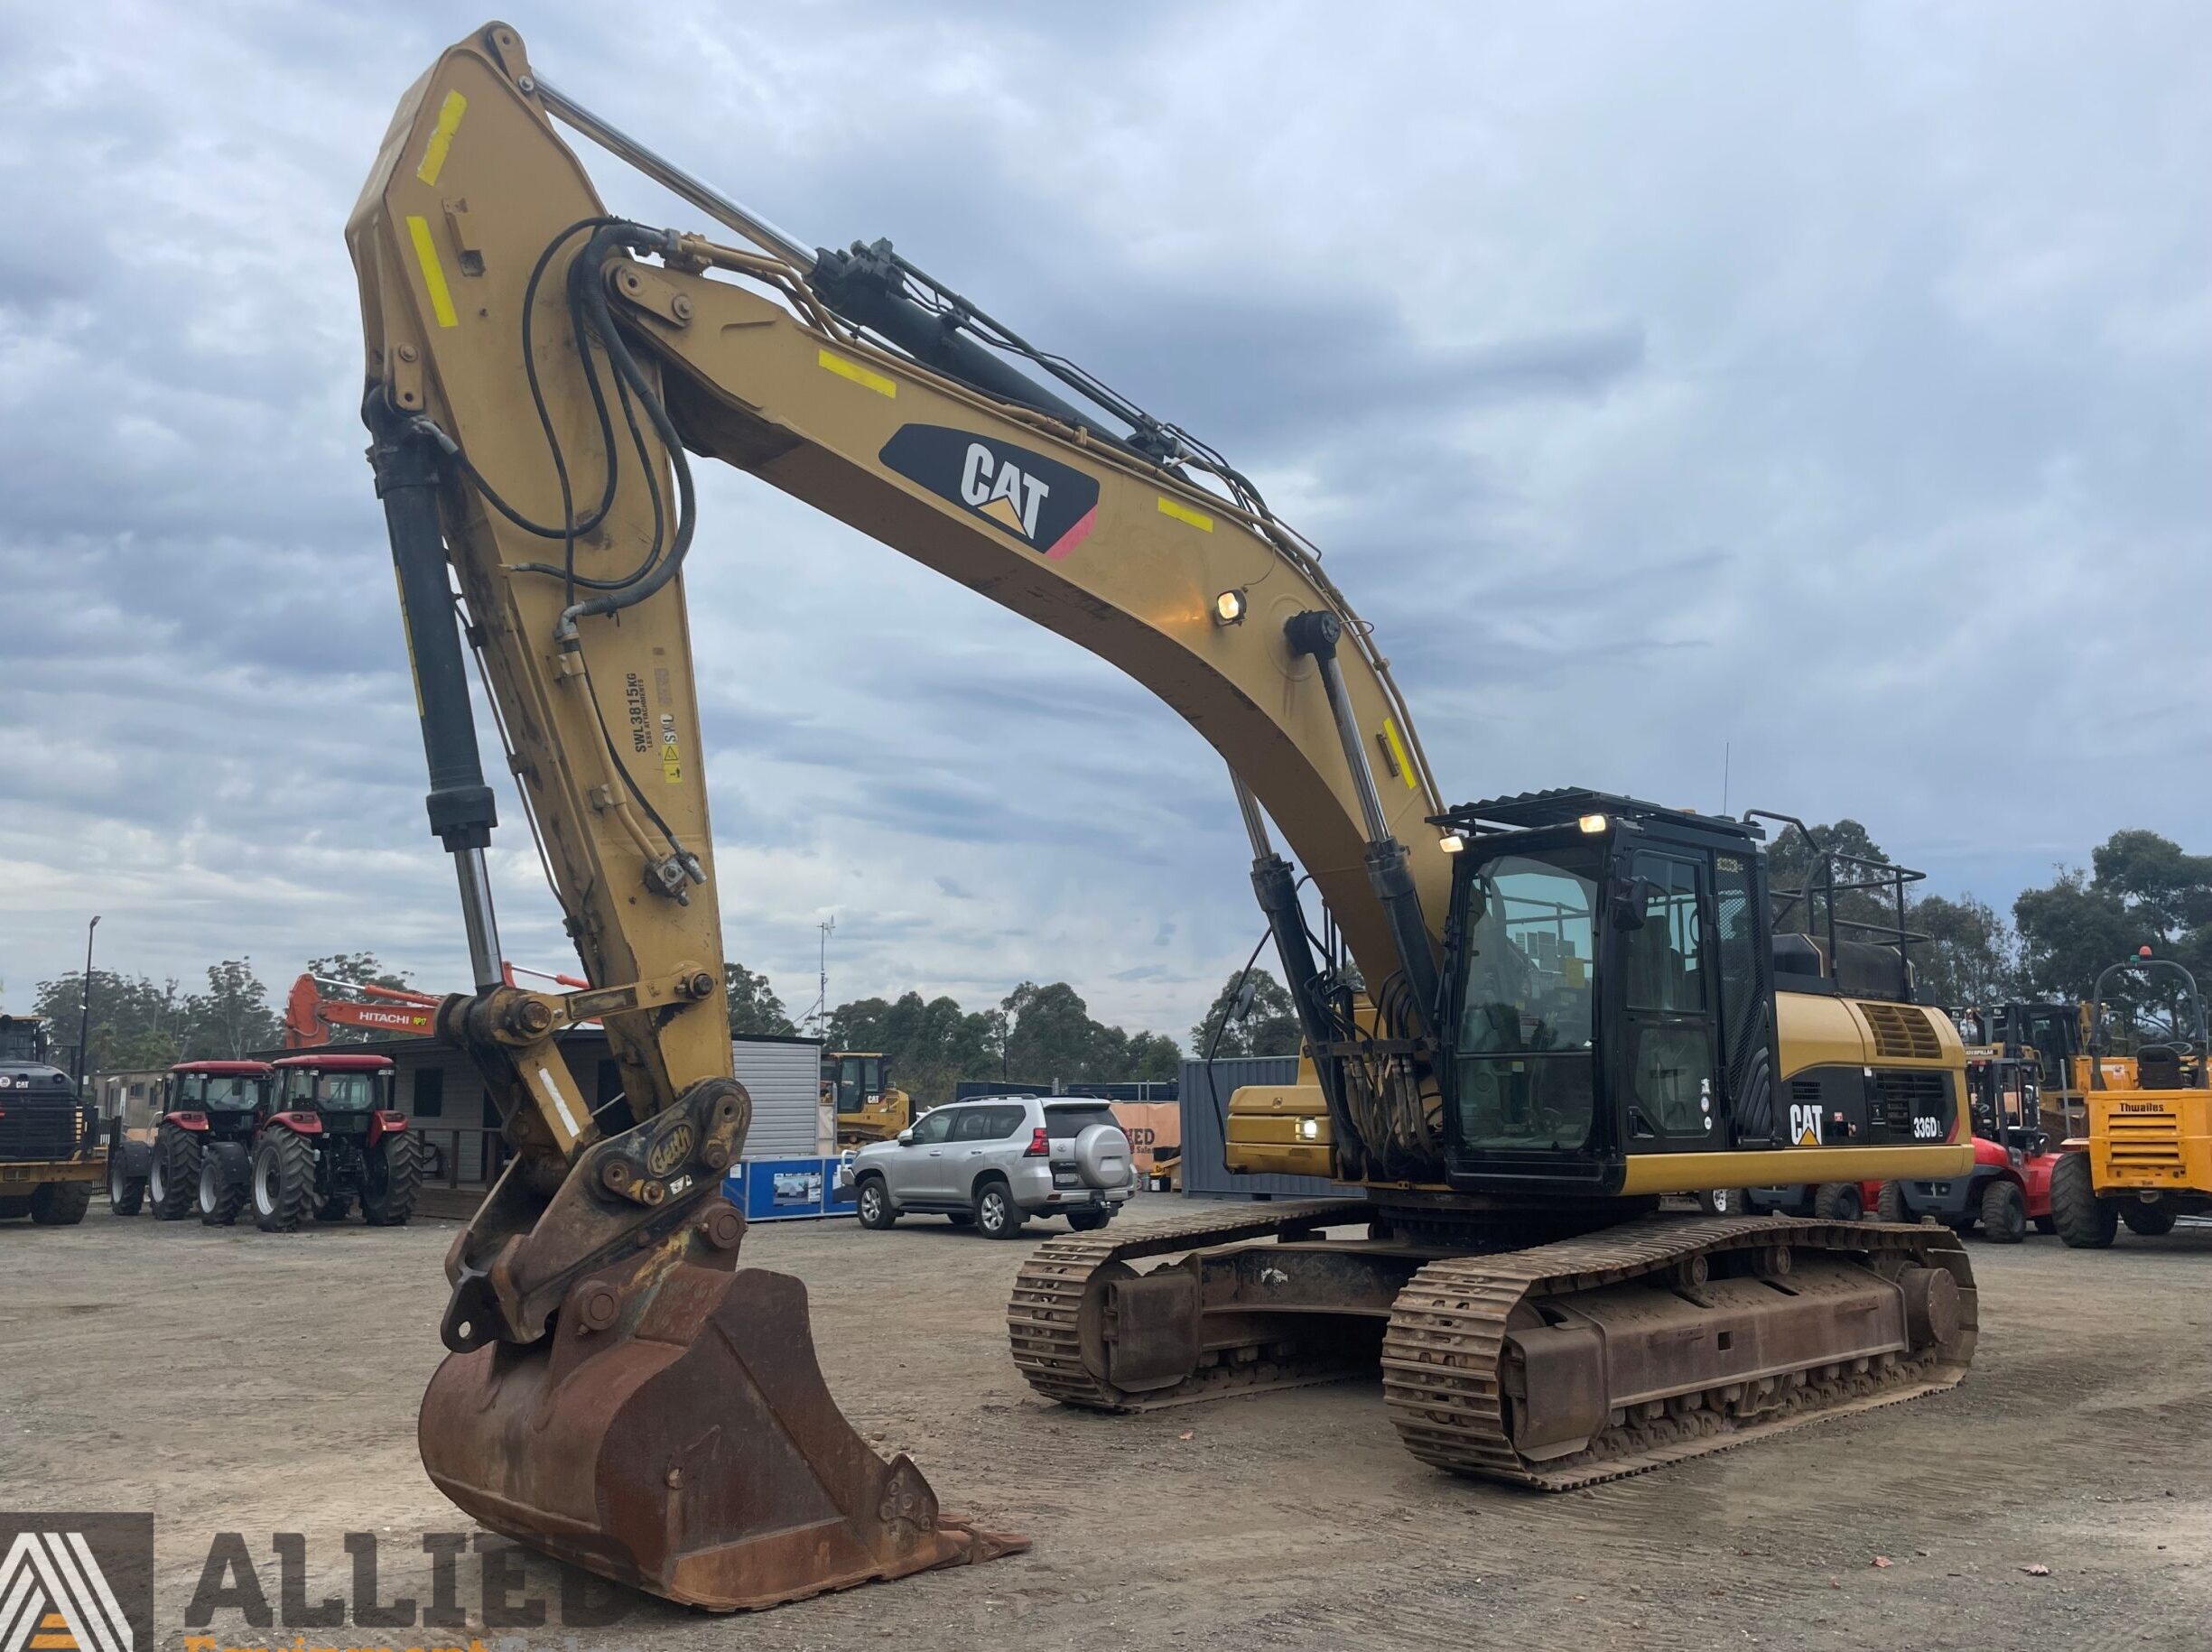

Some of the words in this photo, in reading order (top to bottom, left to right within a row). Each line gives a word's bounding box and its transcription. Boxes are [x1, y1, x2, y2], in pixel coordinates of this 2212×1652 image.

[961, 442, 1049, 540] CAT
[638, 679, 651, 729] ATTACHMENTS
[359, 1012, 409, 1025] HITACHI
[16, 1081, 29, 1089] CAT
[868, 1095, 879, 1104] CAT
[2120, 1102, 2164, 1112] Thwaites
[1789, 1104, 1823, 1145] CAT
[1914, 1117, 1937, 1137] 336D
